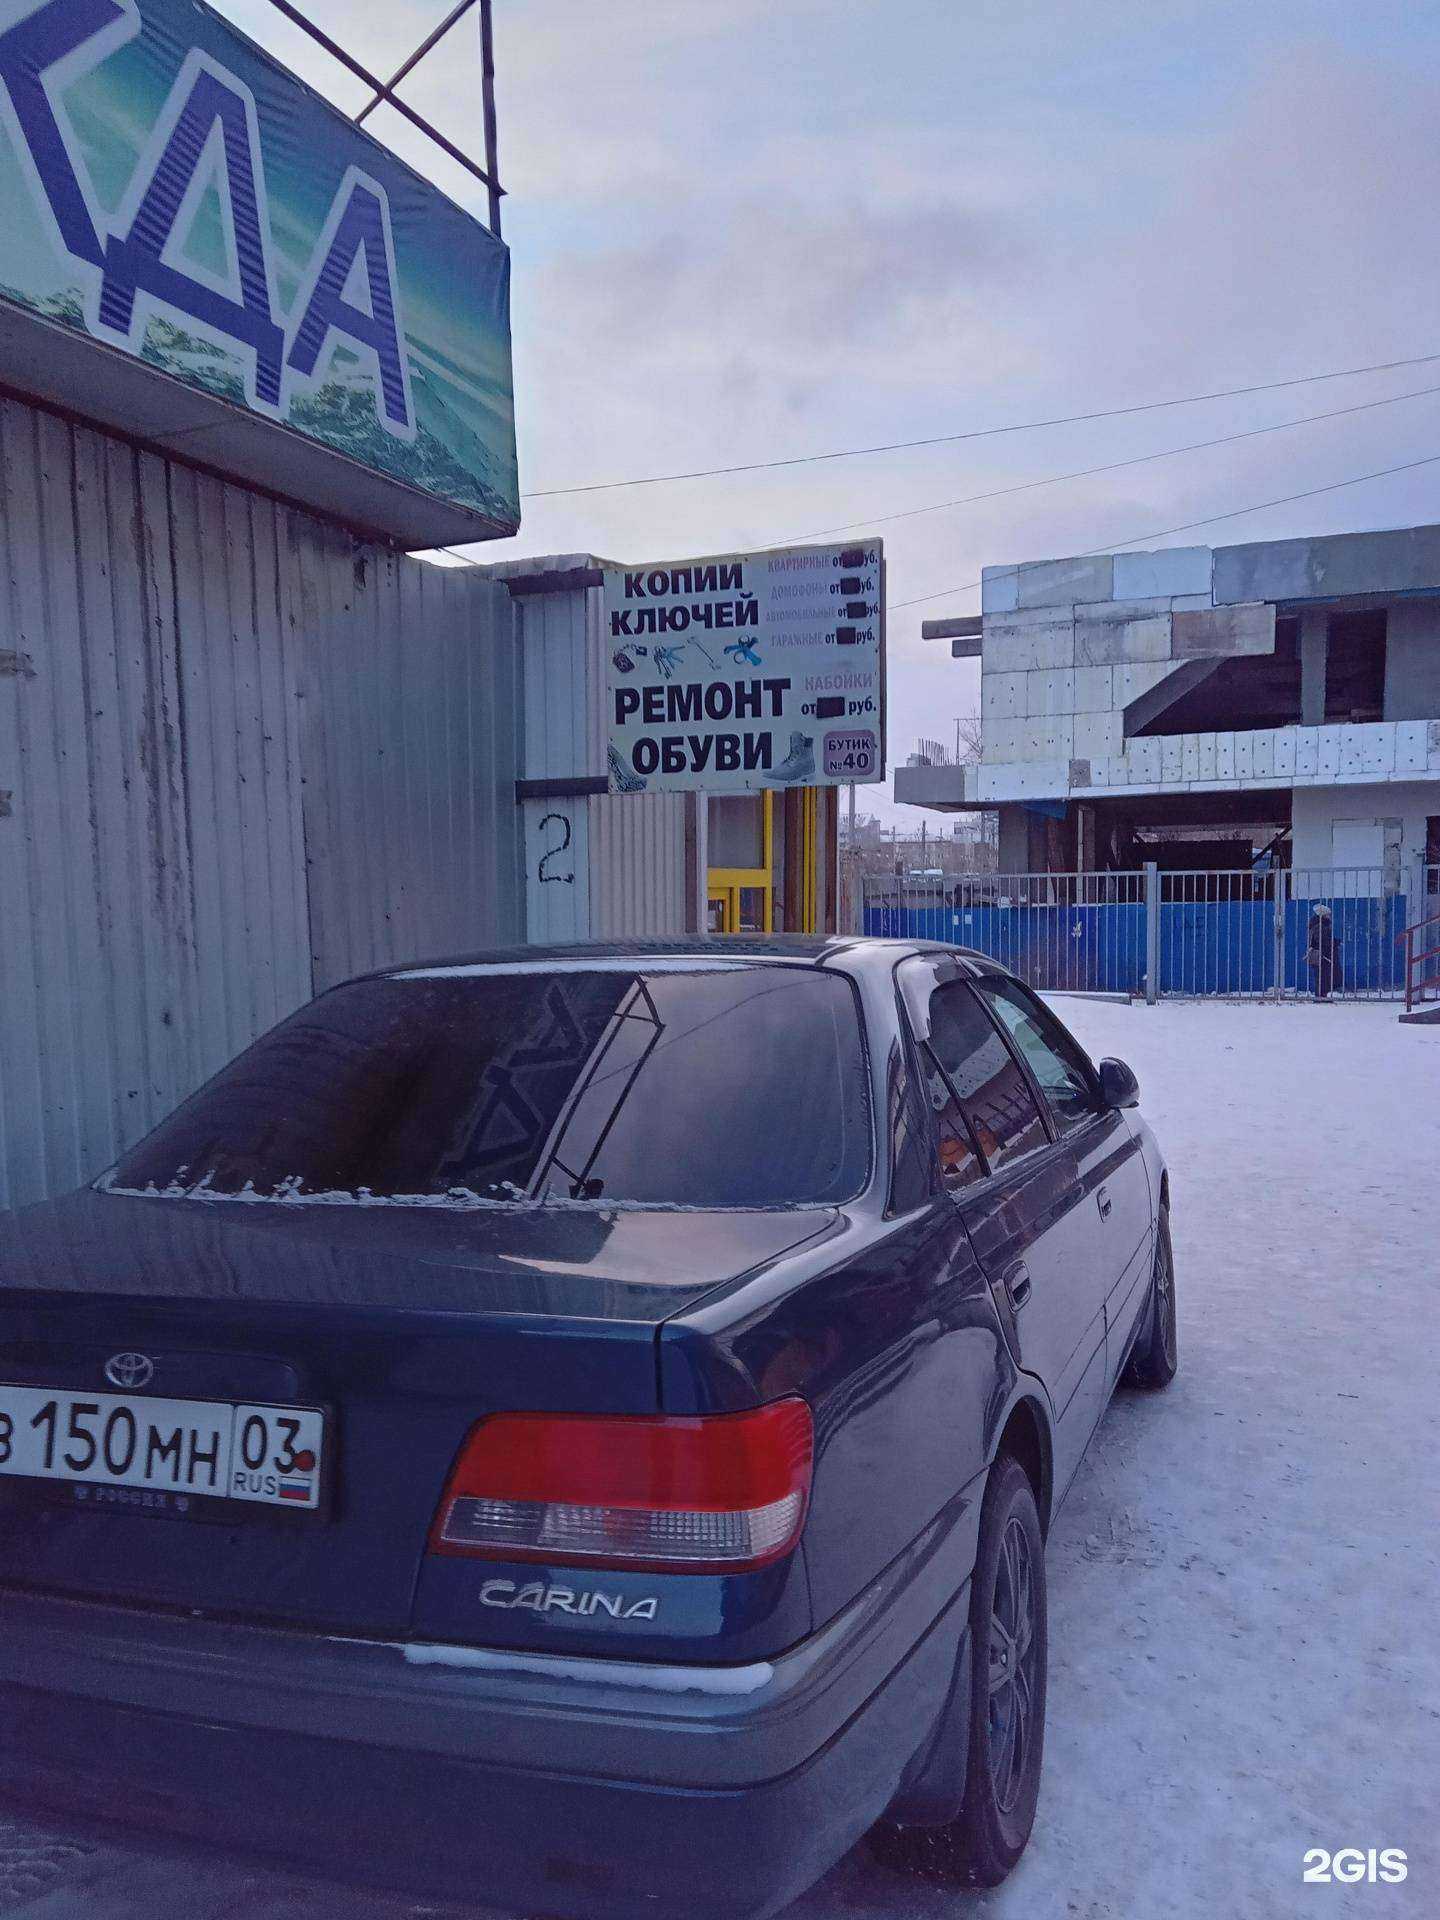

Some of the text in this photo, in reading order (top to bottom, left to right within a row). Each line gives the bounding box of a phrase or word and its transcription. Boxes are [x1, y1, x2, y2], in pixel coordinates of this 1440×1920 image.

[624, 563, 743, 599] КОПИИ
[611, 591, 759, 636] КЛЮЧЕЙ
[615, 678, 792, 725] РЕМОНТ
[801, 696, 877, 717] от руб.
[632, 731, 772, 775] ОБУВИ
[828, 738, 870, 751] БУТИК
[538, 813, 574, 883] 2
[233, 1471, 277, 1497] RUS
[479, 1578, 658, 1622] CARINA
